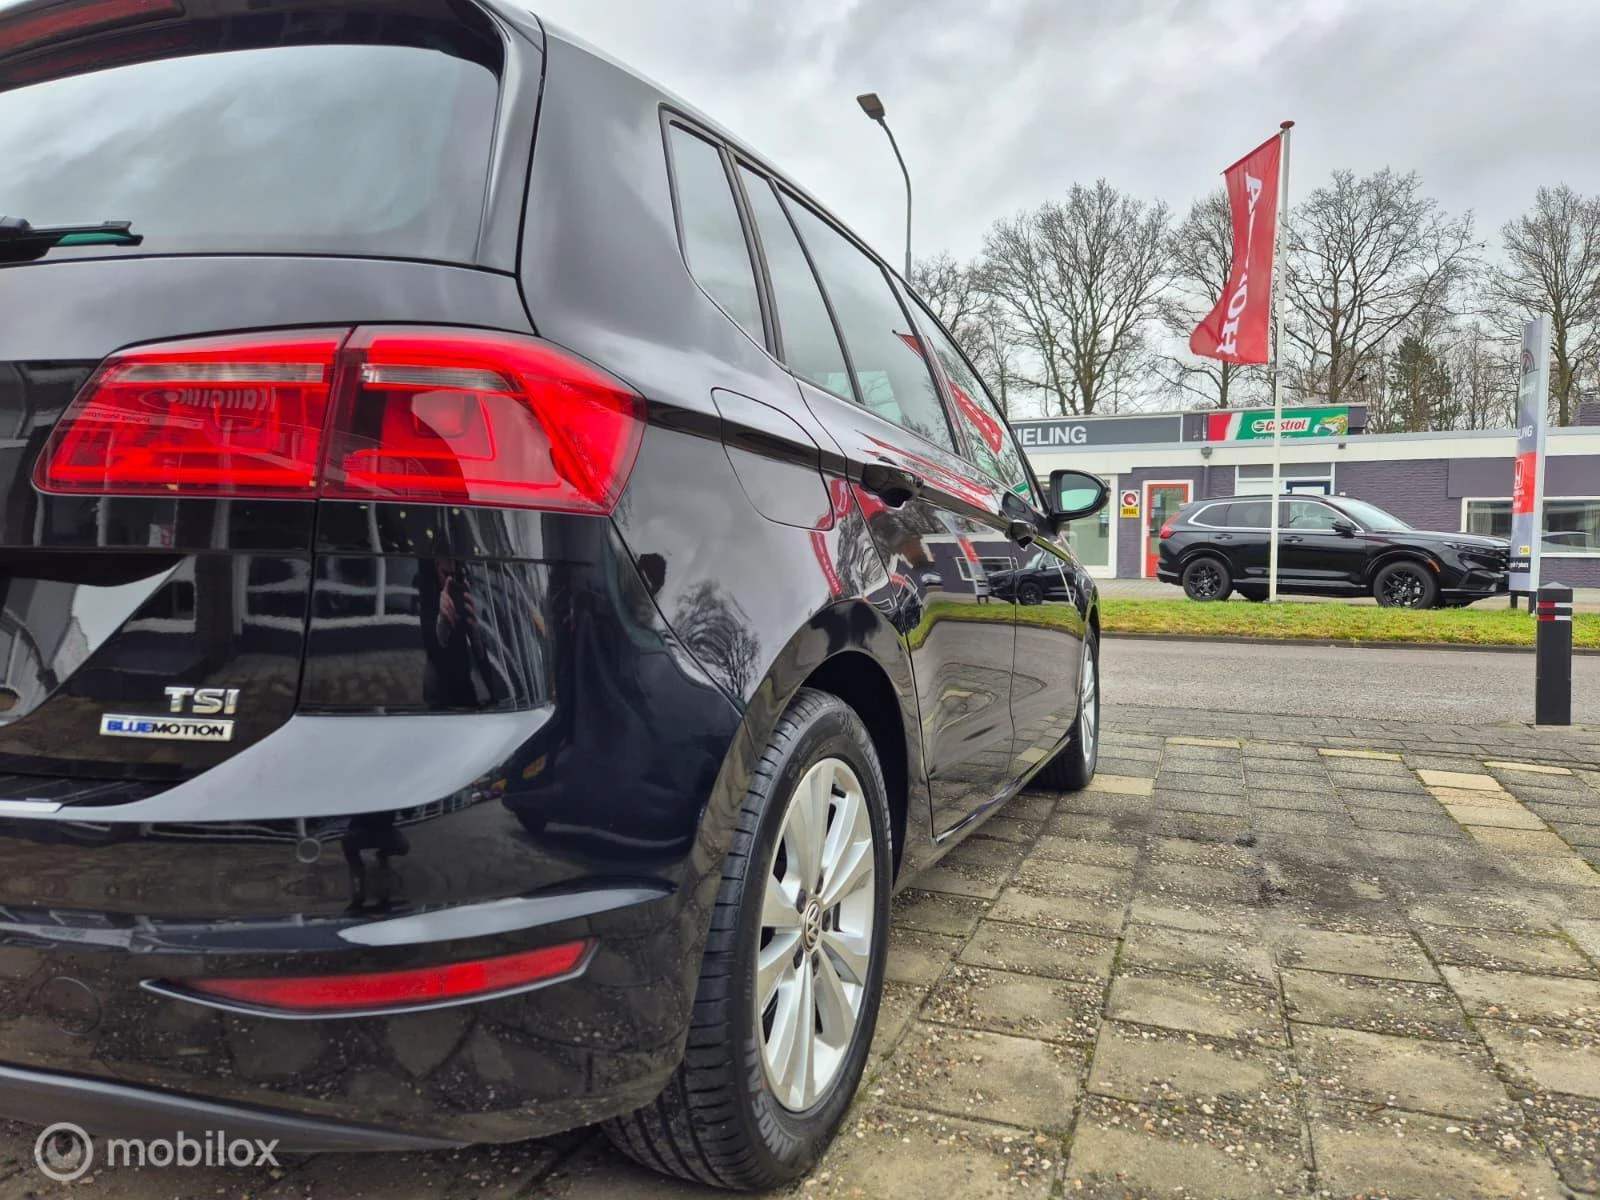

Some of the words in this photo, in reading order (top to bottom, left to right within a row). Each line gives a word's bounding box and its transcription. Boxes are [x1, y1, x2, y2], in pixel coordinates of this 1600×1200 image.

[1216, 172, 1263, 357] HOA
[1265, 419, 1306, 432] Cstrol
[1014, 426, 1088, 446] IELING
[164, 686, 240, 715] TSI
[107, 720, 225, 737] BLUEMOTION
